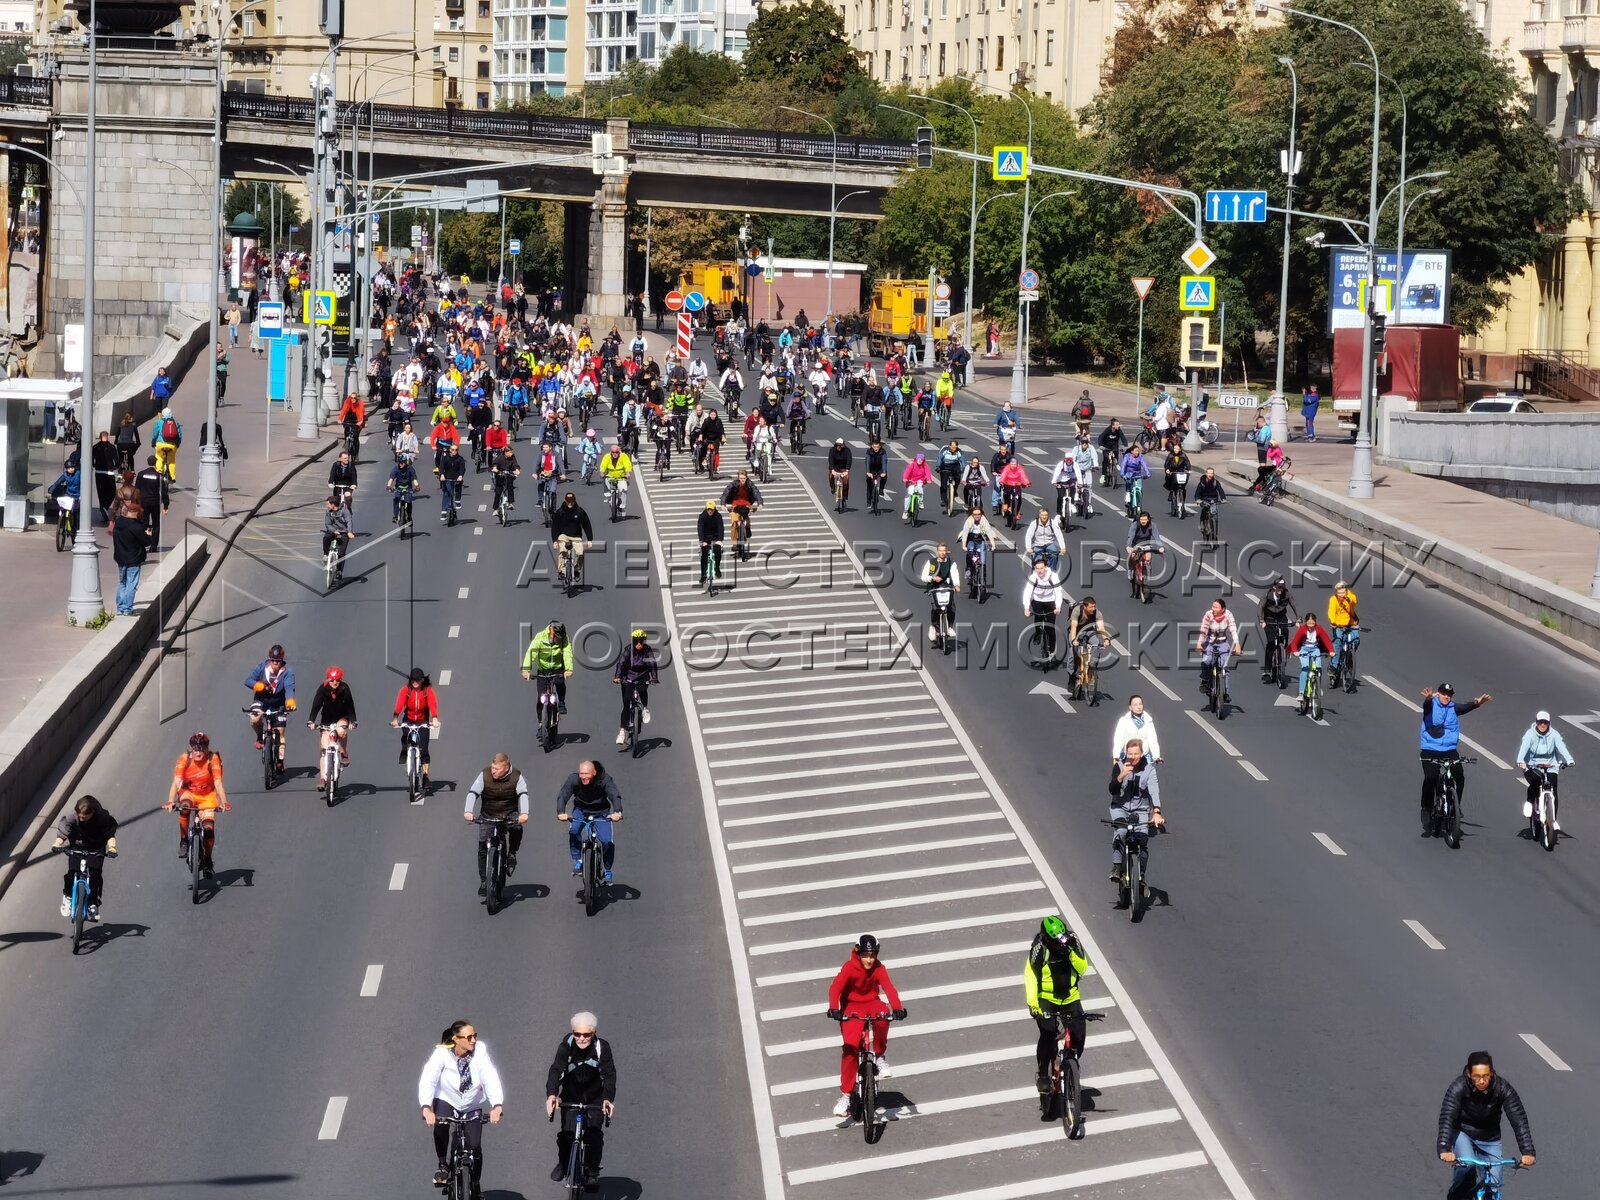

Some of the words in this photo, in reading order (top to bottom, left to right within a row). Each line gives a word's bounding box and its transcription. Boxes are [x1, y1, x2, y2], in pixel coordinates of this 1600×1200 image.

[1340, 255, 1388, 264] ПЕРЕВЕТЕ
[1424, 261, 1443, 270] ВТБ
[1224, 396, 1254, 406] СТОП
